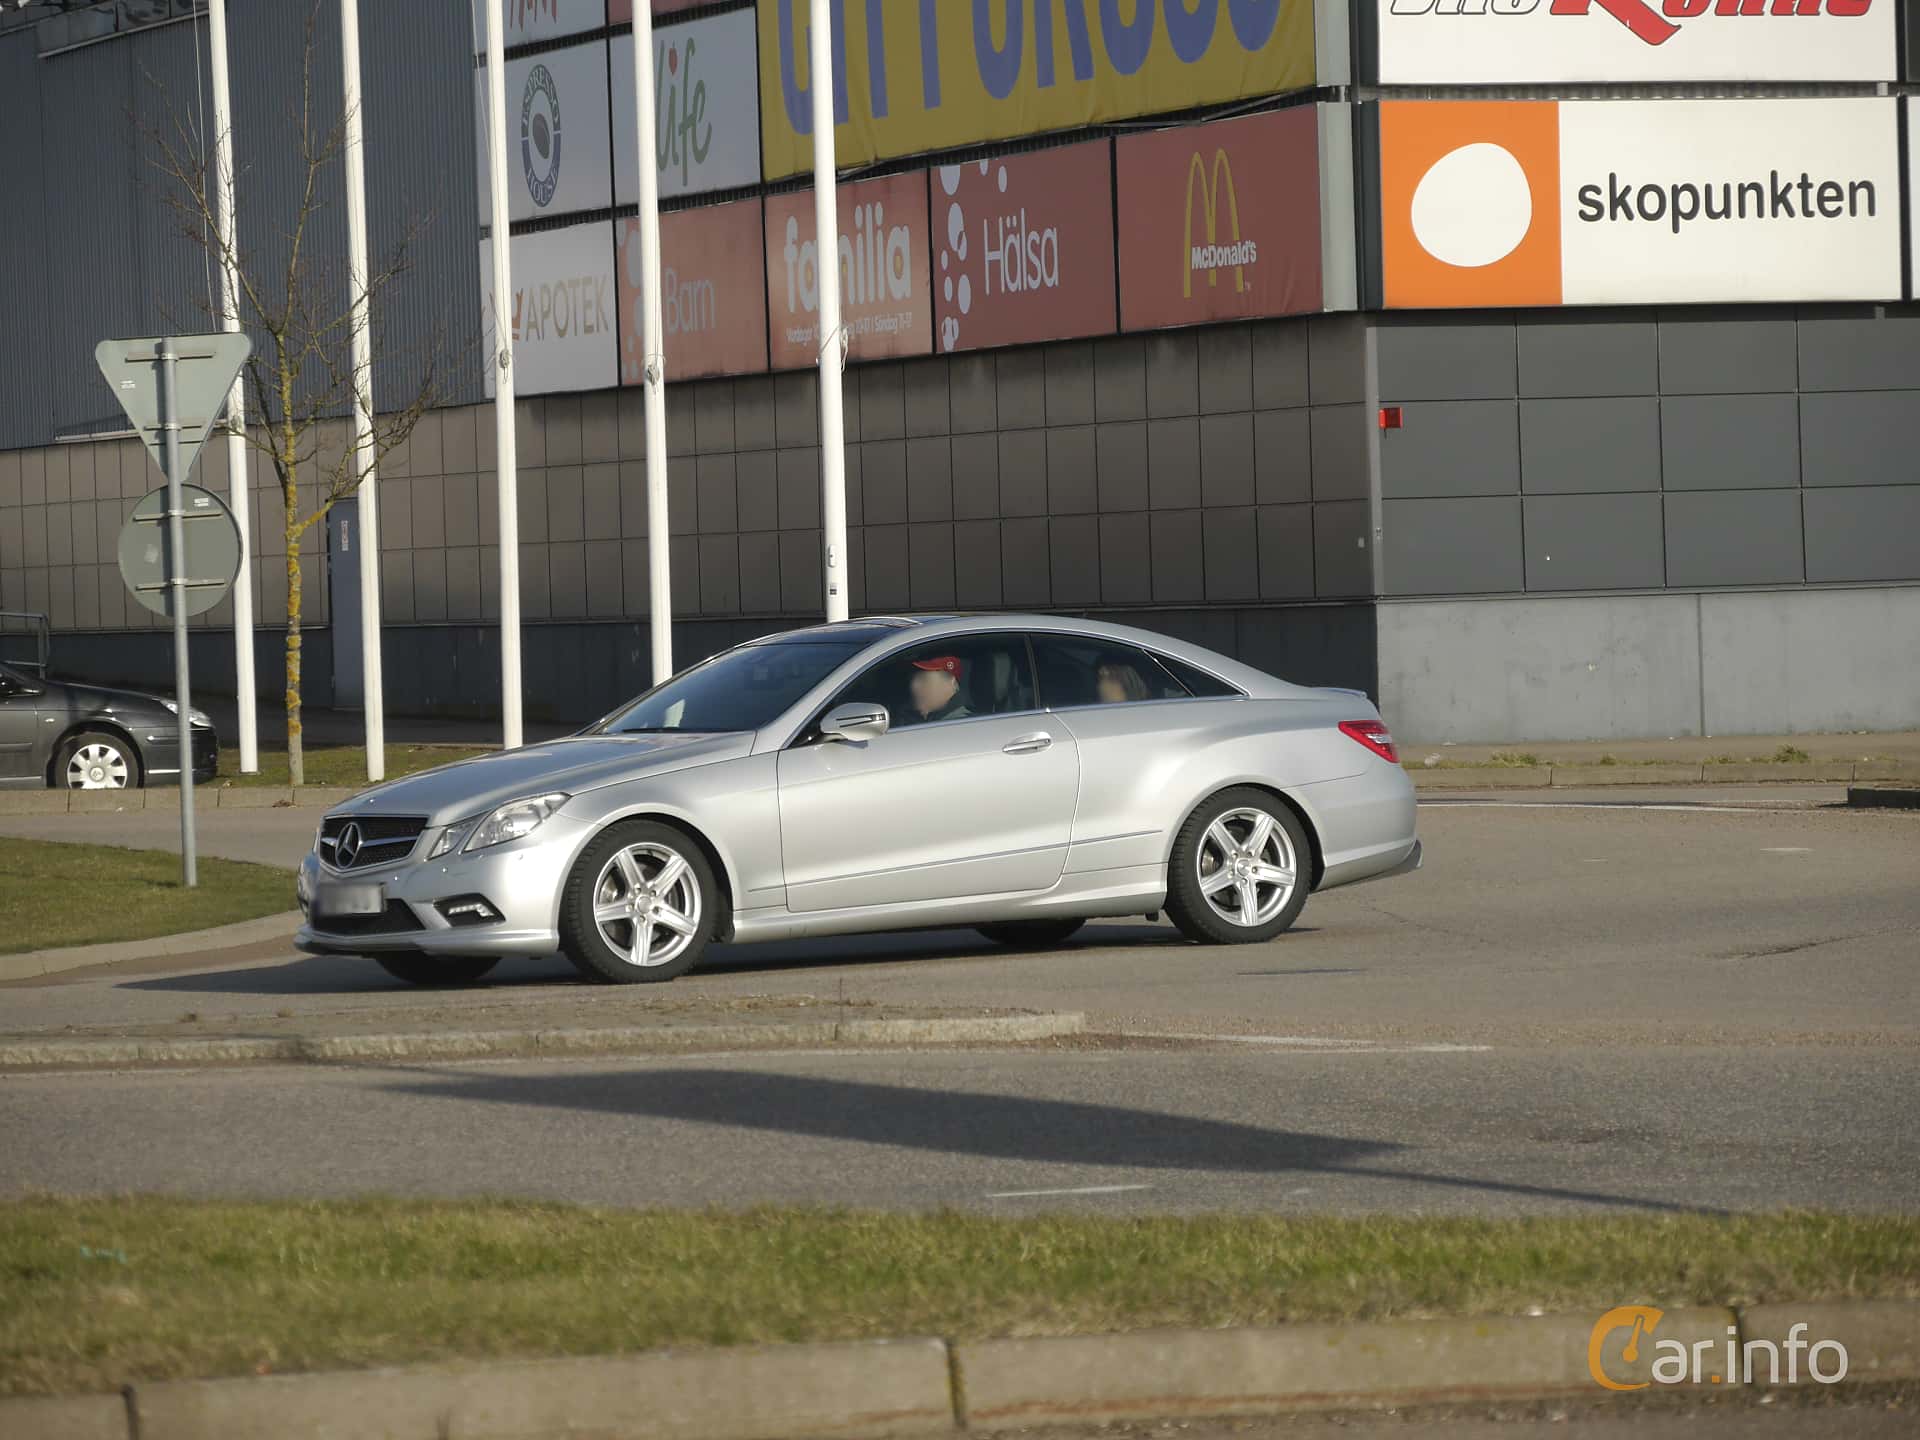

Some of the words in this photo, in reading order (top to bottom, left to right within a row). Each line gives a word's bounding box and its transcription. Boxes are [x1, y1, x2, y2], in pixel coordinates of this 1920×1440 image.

[1577, 169, 1876, 234] skopunkten
[983, 207, 1059, 297] Hälsa
[1191, 239, 1257, 270] McDonald's
[525, 274, 609, 342] APOTEK
